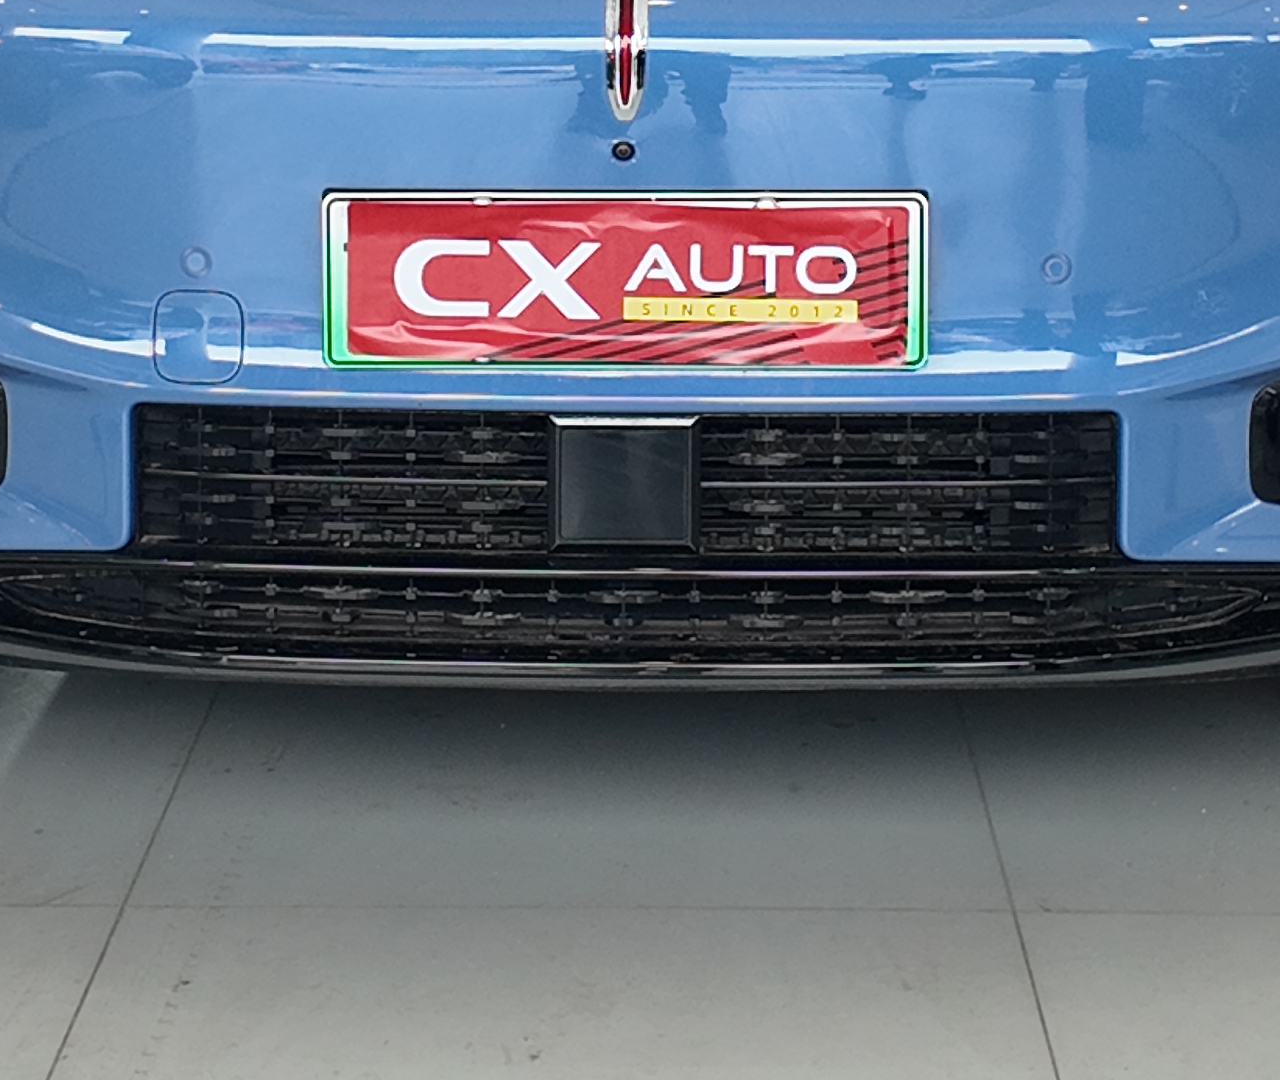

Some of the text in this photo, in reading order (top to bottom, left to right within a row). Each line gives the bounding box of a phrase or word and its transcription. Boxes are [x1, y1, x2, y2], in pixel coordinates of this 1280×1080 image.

[393, 239, 858, 320] CX AUTO
[642, 303, 844, 317] SINCE 2012
